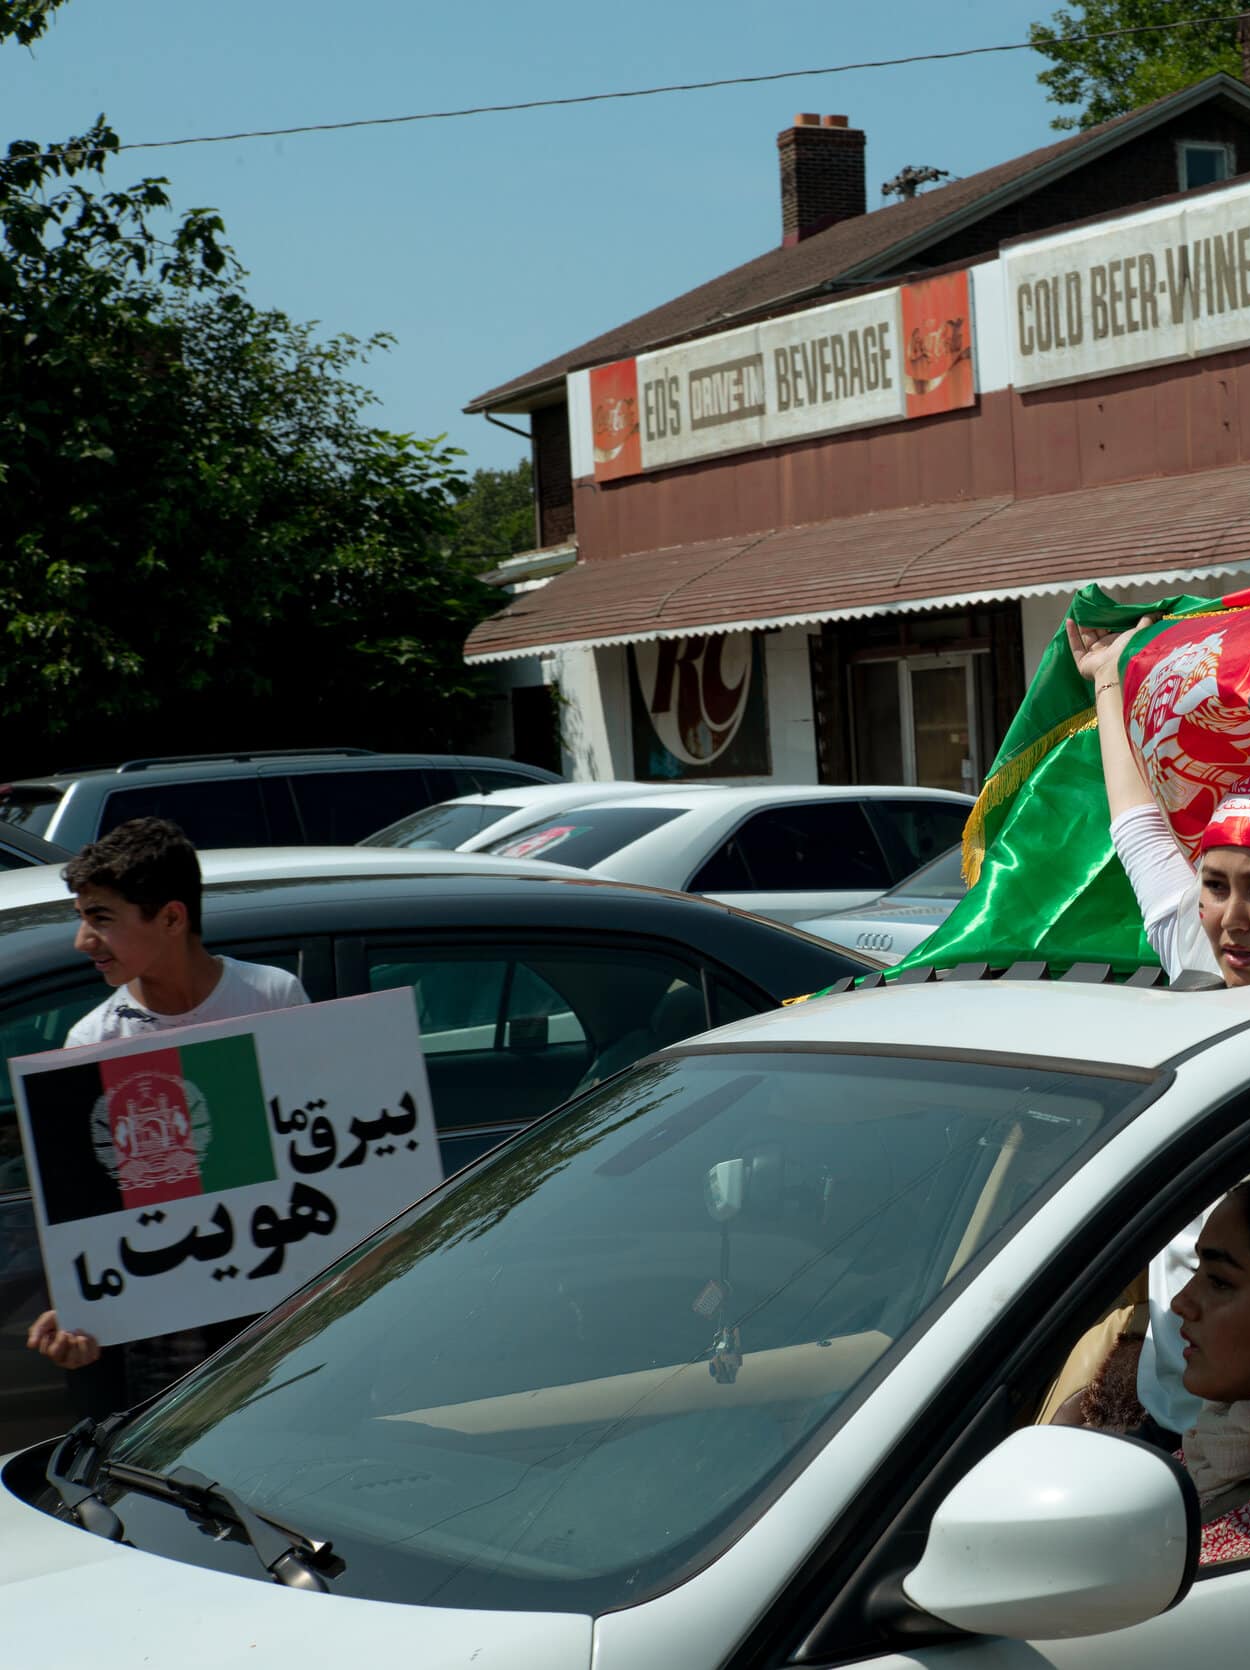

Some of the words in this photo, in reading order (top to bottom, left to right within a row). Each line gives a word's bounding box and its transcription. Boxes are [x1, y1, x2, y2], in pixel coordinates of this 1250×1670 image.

[1016, 269, 1083, 356] COLD
[644, 366, 681, 442] ED'S
[774, 321, 892, 413] BEVERAGE
[269, 1094, 307, 1136] ما
[118, 1181, 338, 1282] هویت
[71, 1251, 126, 1302] ما
